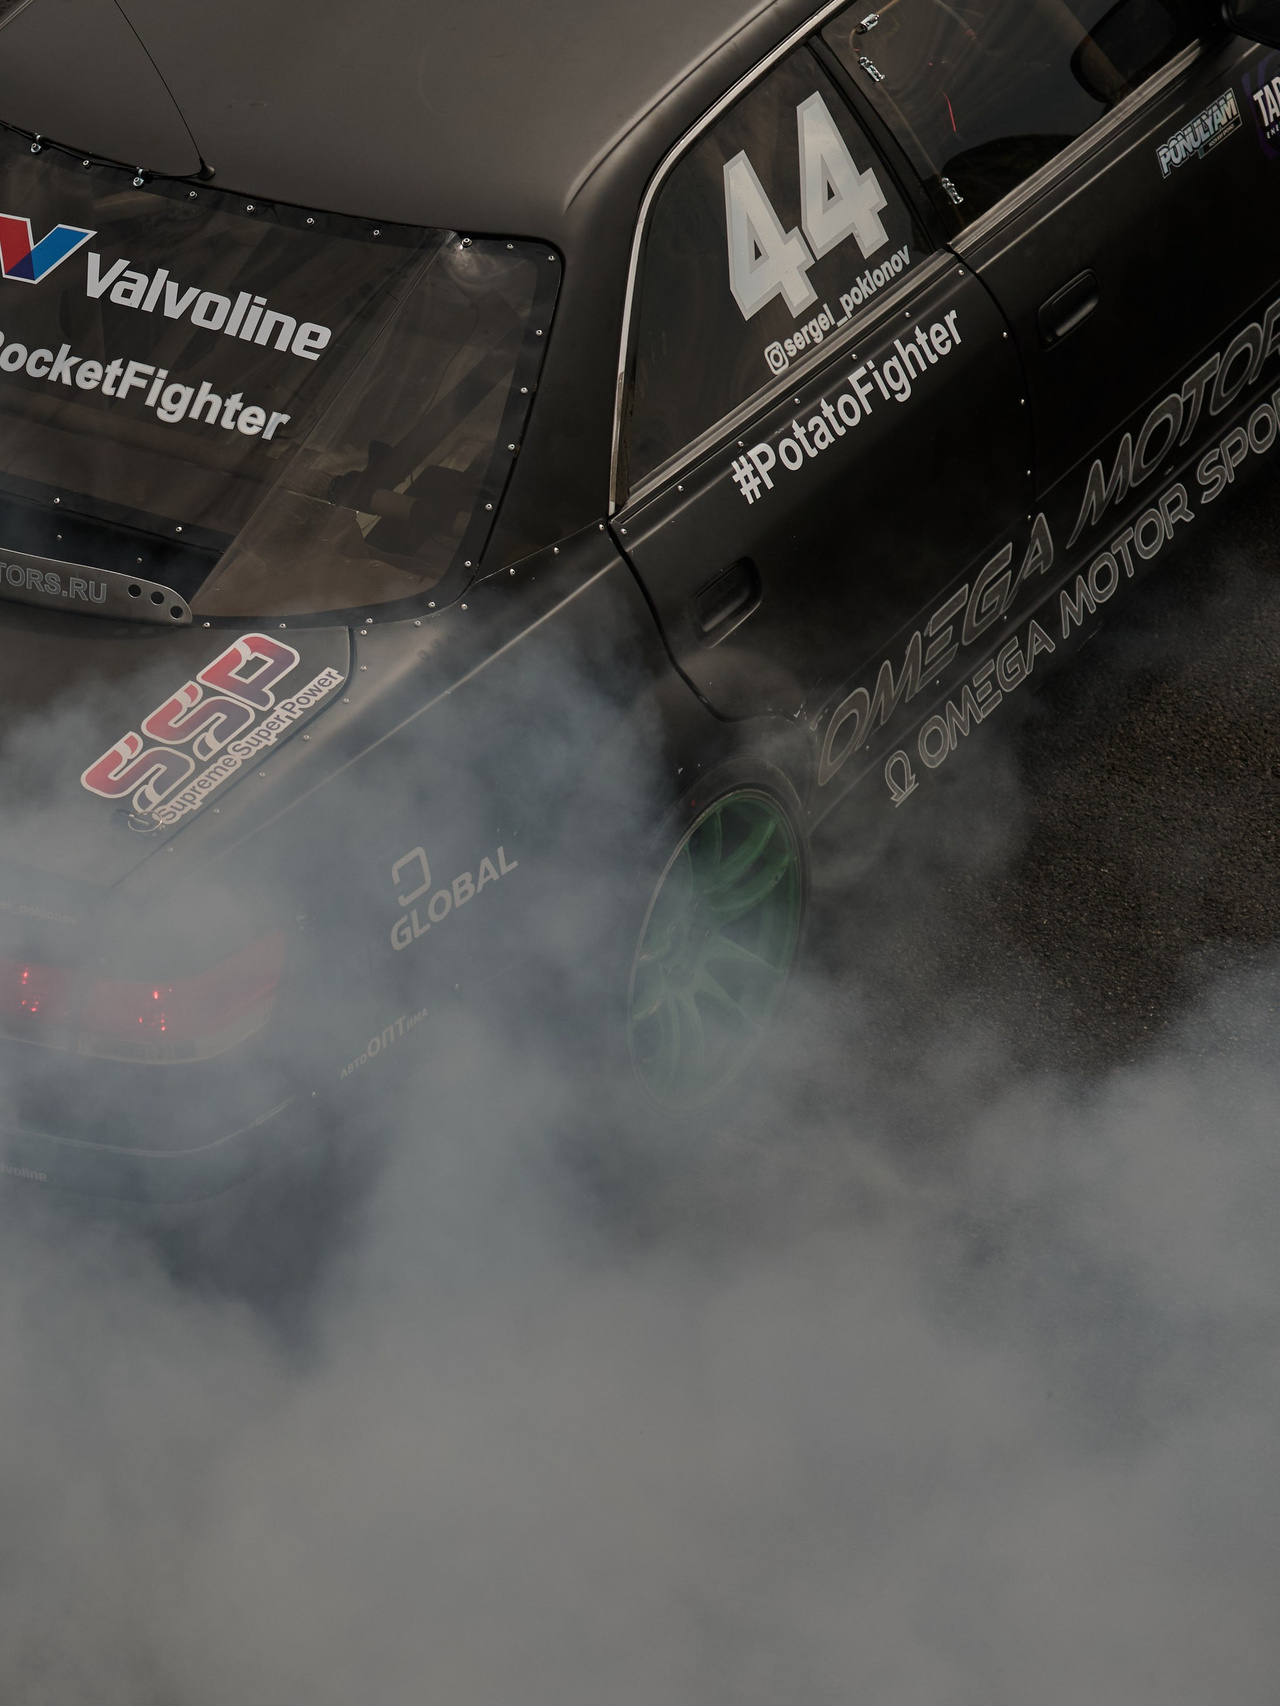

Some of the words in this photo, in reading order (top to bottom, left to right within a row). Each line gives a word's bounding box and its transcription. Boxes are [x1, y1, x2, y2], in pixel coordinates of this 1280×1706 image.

[723, 91, 888, 322] 44
[1158, 91, 1238, 174] PONULYAM
[85, 252, 332, 361] Valvoline
[732, 310, 963, 505] #PotatoFighter
[820, 513, 1054, 786] OMEGA
[918, 621, 1055, 768] OMEGA
[1059, 484, 1195, 638] MOTOR
[391, 846, 518, 951] GLOBAL
